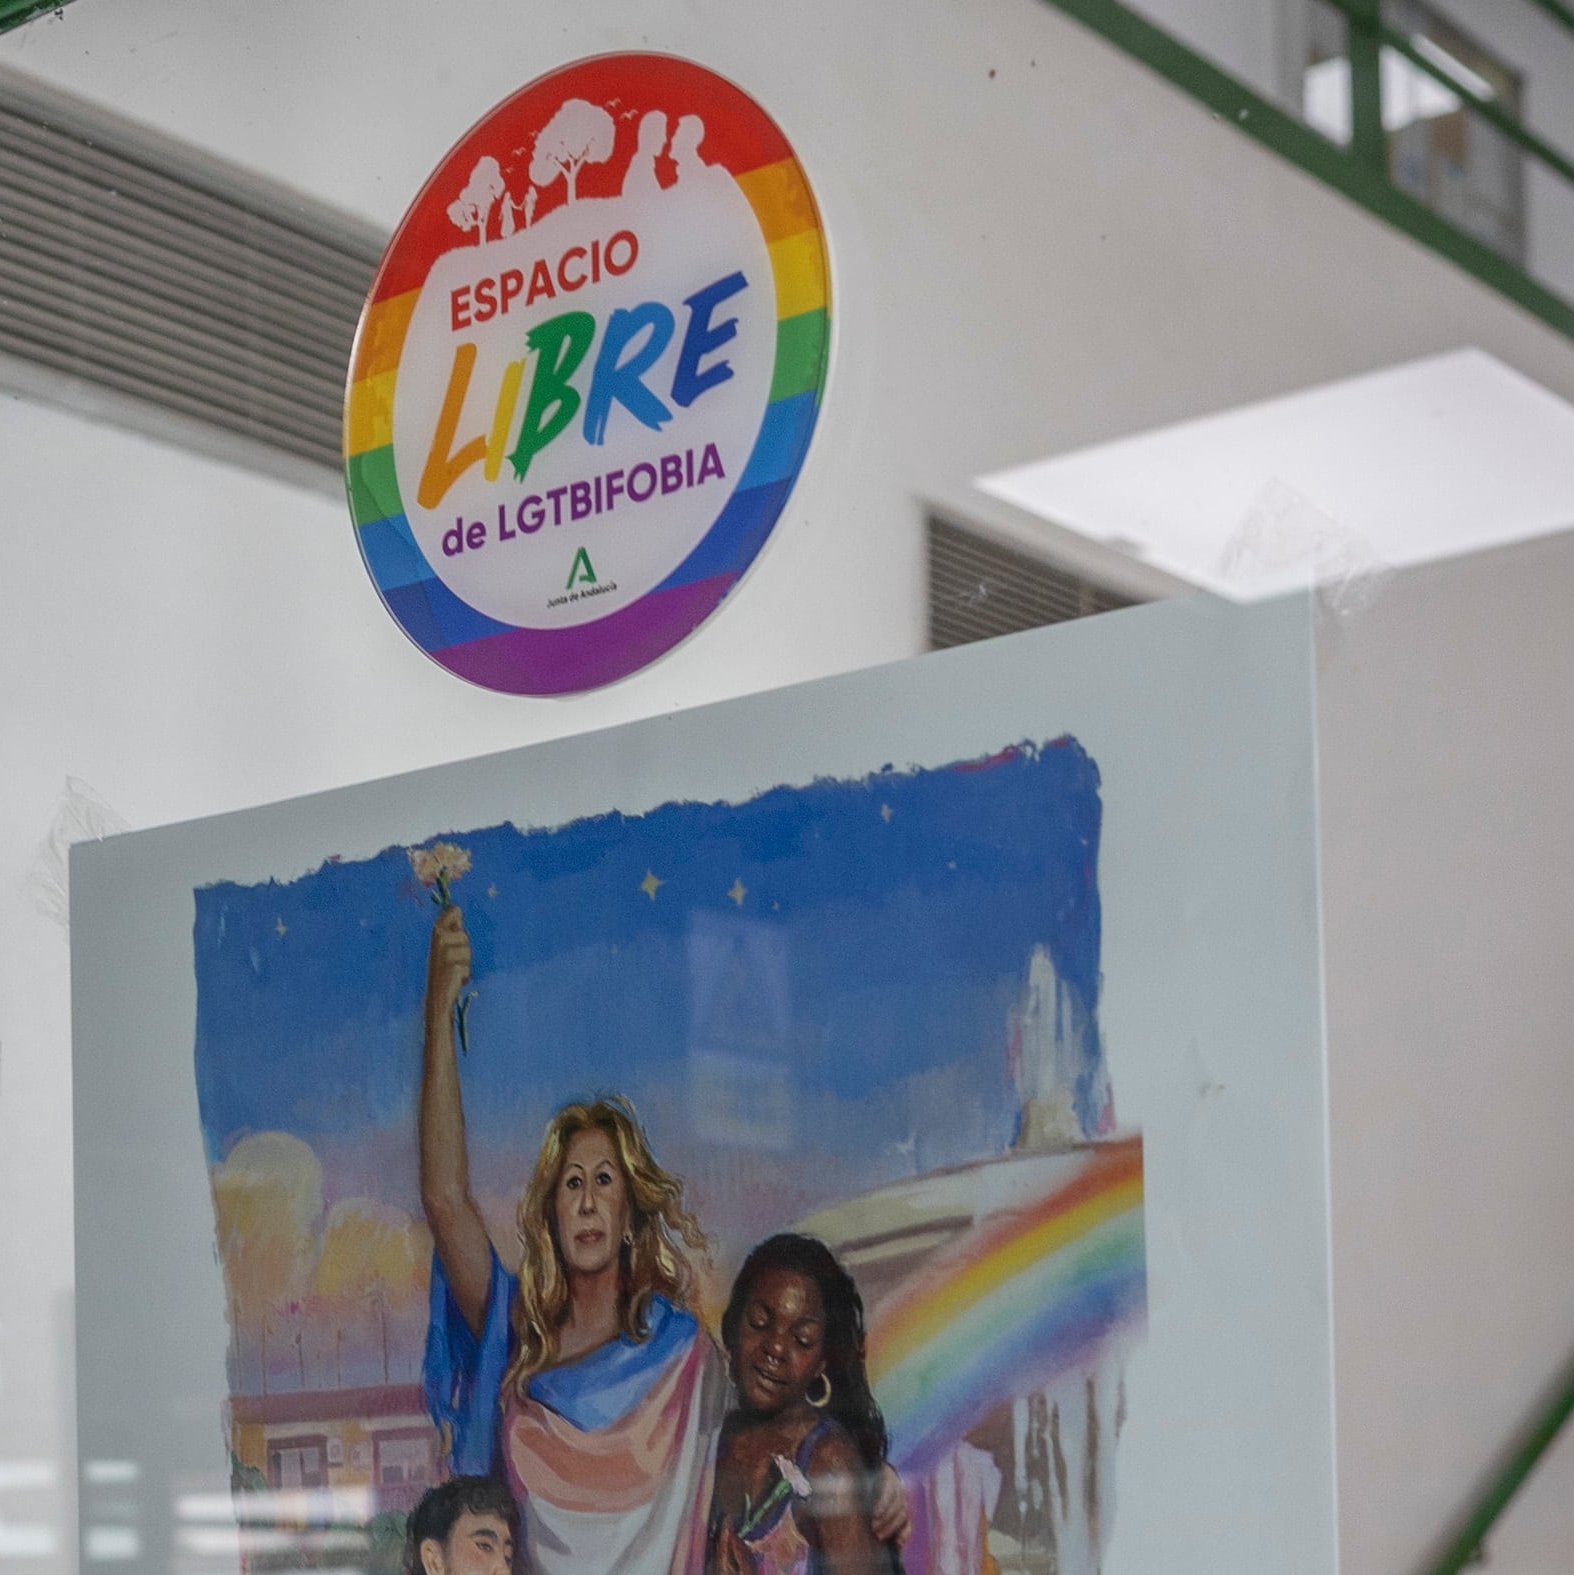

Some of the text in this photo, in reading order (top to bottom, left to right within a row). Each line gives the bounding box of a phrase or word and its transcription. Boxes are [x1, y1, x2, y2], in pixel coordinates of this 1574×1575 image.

[450, 229, 639, 332] ESPACIO
[417, 270, 749, 510] LIBRE
[441, 442, 726, 556] de LGTBIFOBIA
